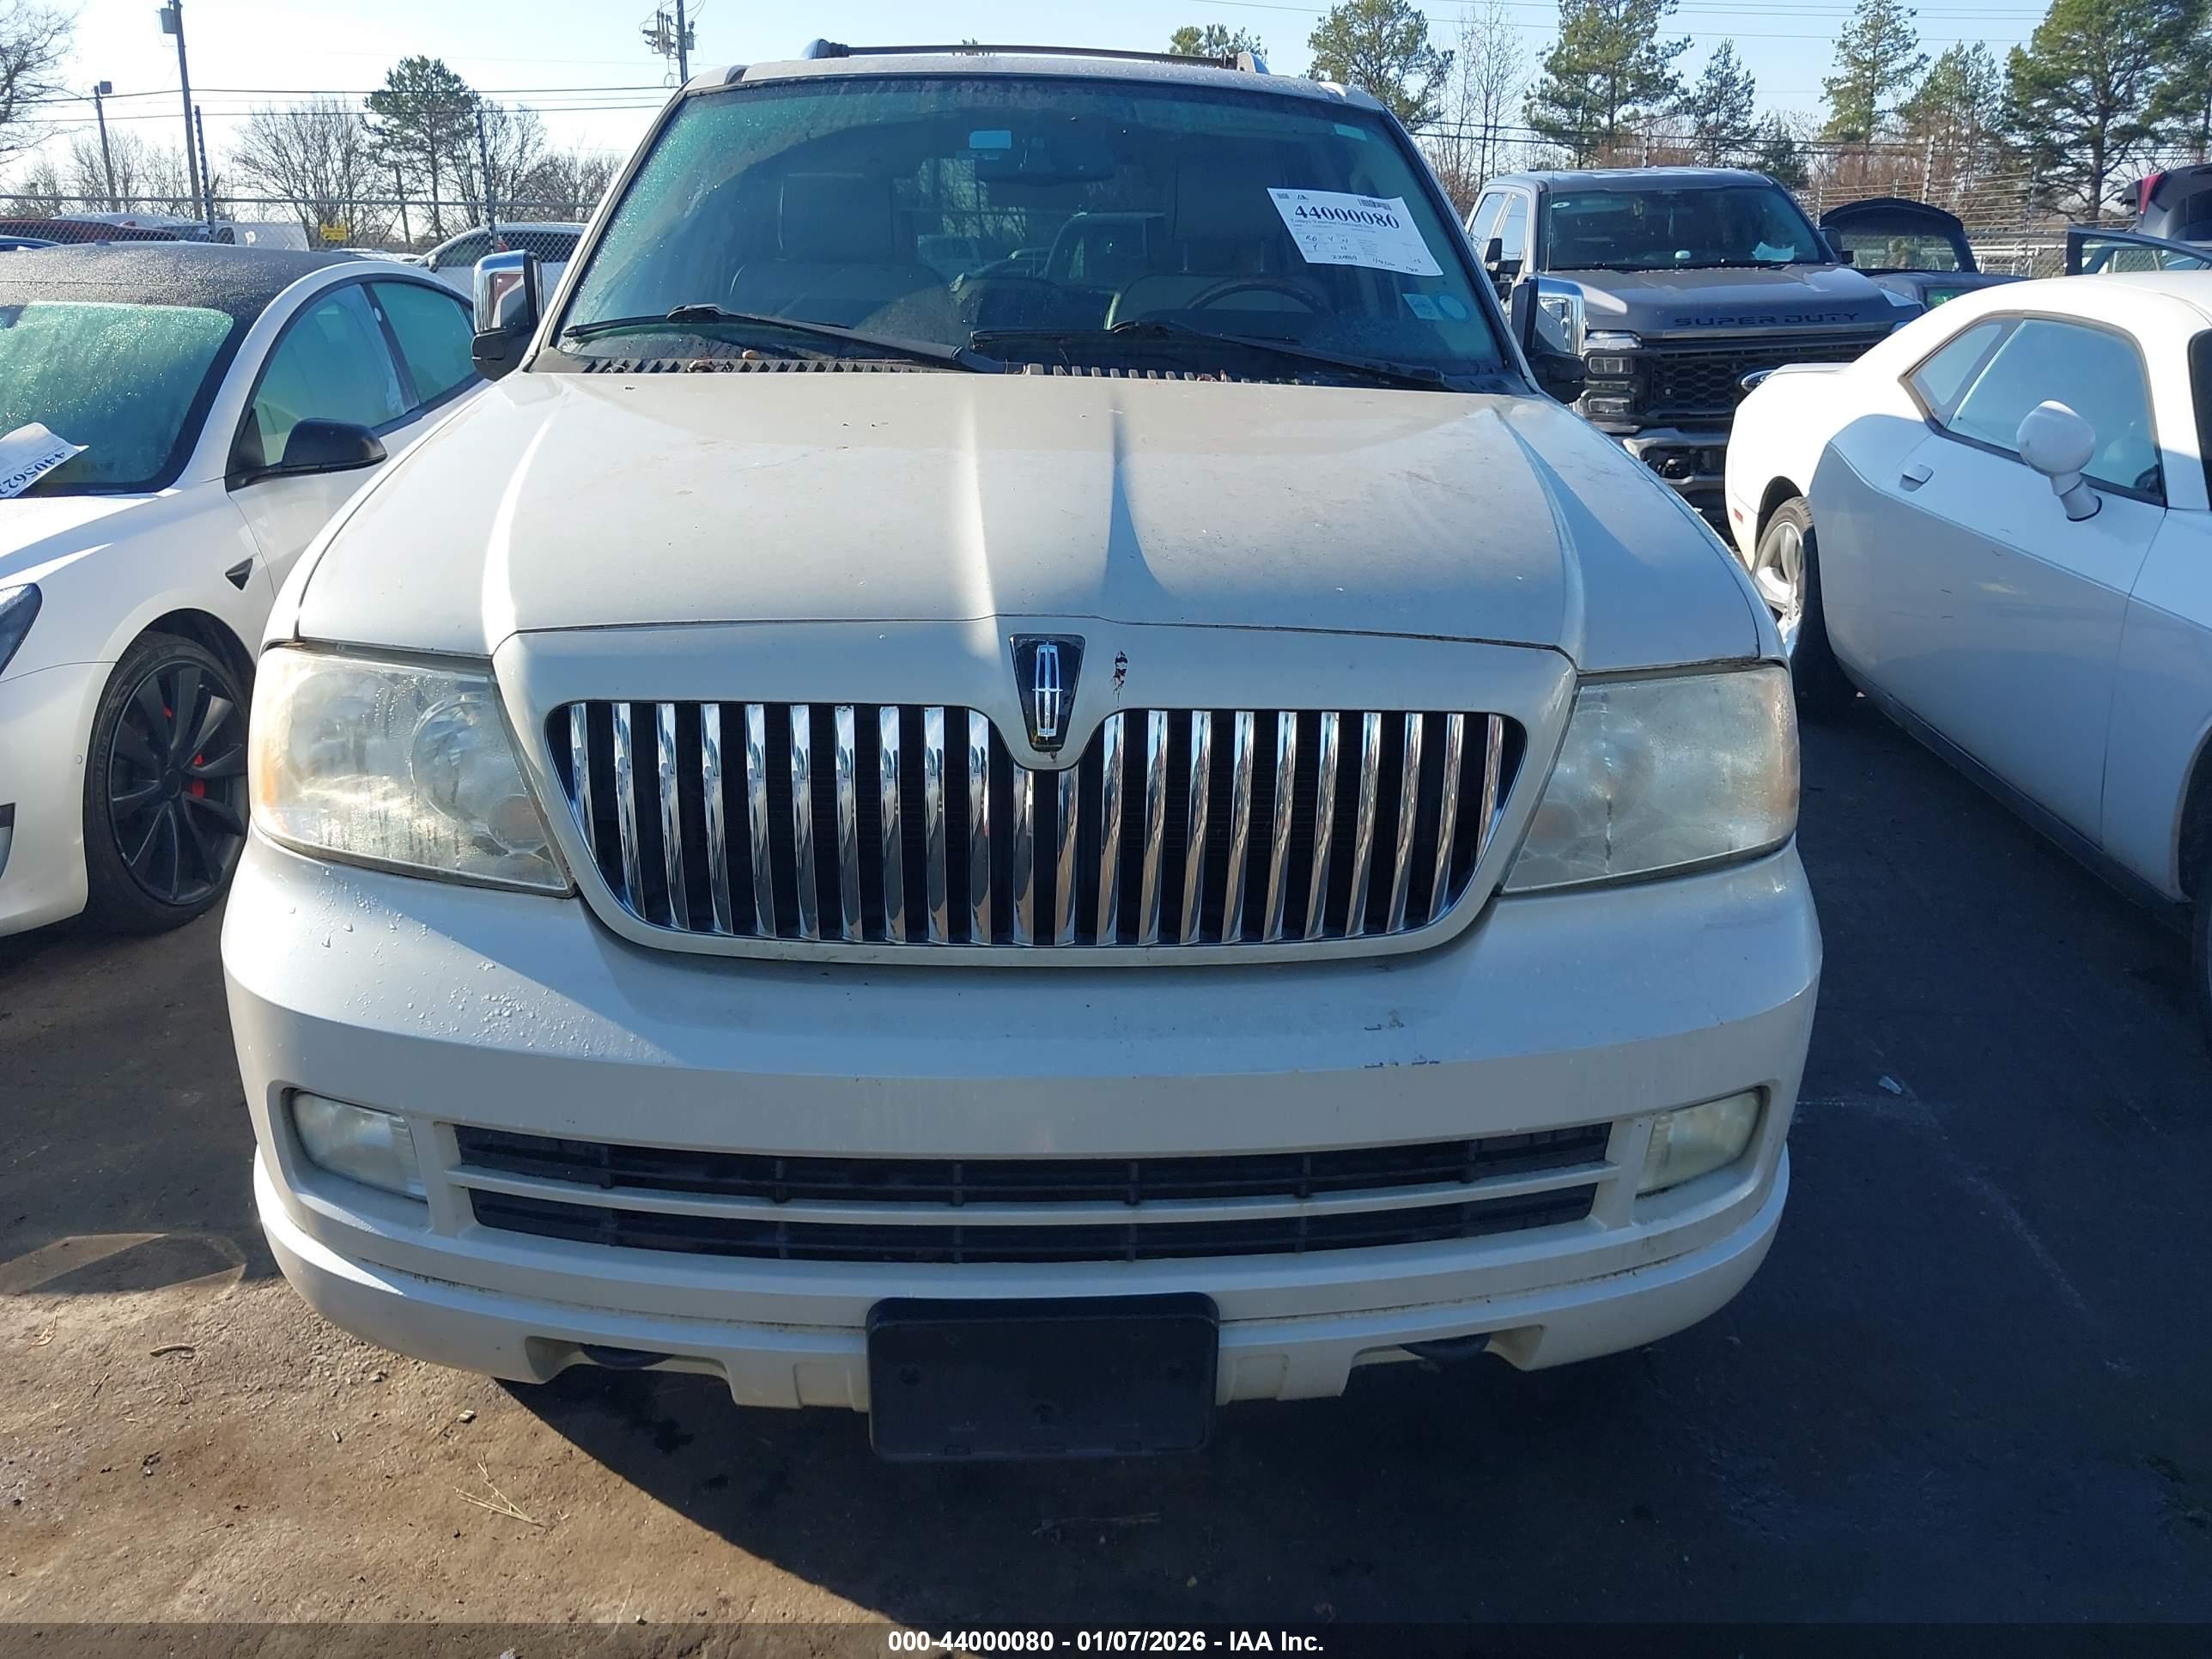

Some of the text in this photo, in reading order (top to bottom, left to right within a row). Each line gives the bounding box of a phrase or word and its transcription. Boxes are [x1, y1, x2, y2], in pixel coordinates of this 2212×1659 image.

[1295, 205, 1400, 228] 44000080
[1674, 313, 1859, 326] SUPER DUTY
